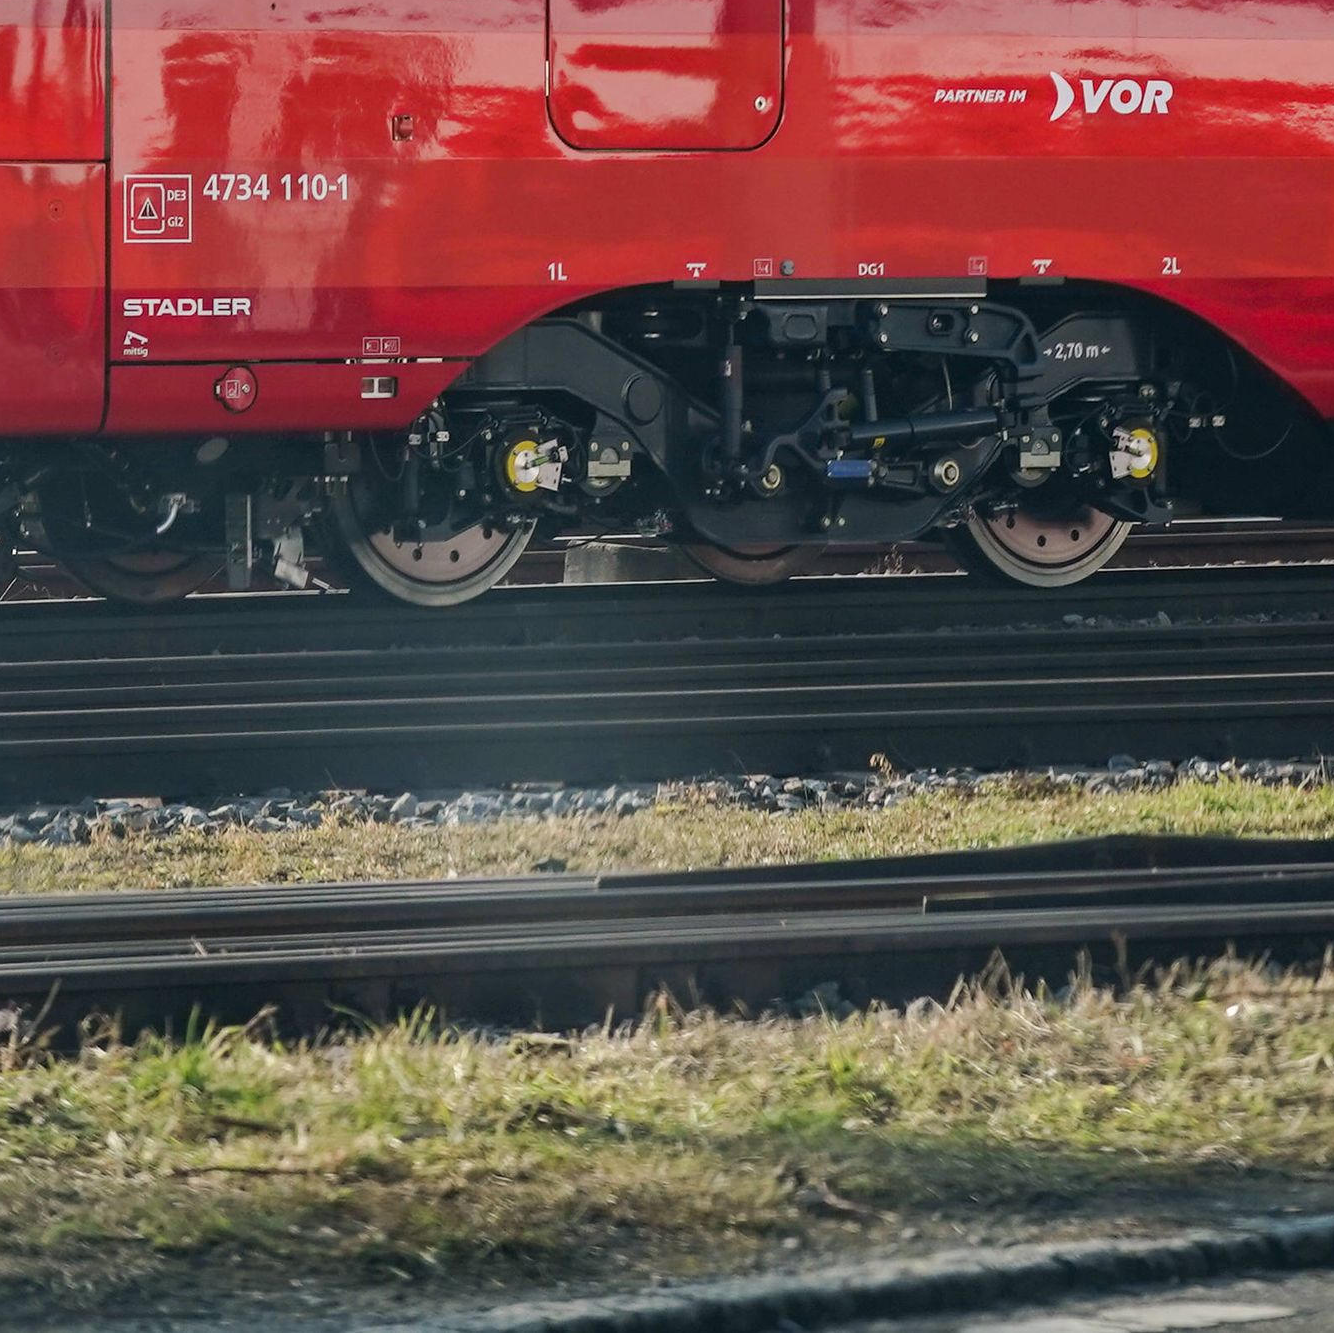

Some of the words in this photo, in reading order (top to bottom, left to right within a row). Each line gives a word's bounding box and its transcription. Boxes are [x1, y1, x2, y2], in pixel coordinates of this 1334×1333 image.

[934, 89, 1005, 104] PARTNER
[1007, 89, 1028, 103] IM
[1079, 78, 1174, 115] VOR
[166, 189, 186, 201] DE3
[202, 173, 271, 201] 4734
[280, 173, 349, 201] 110-1
[547, 262, 568, 281] 1L
[858, 262, 885, 276] DG1
[1162, 257, 1181, 275] 2L
[124, 298, 251, 317] STADLER
[123, 346, 149, 358] mittig
[1054, 342, 1083, 362] 2,70
[1086, 345, 1099, 358] m
